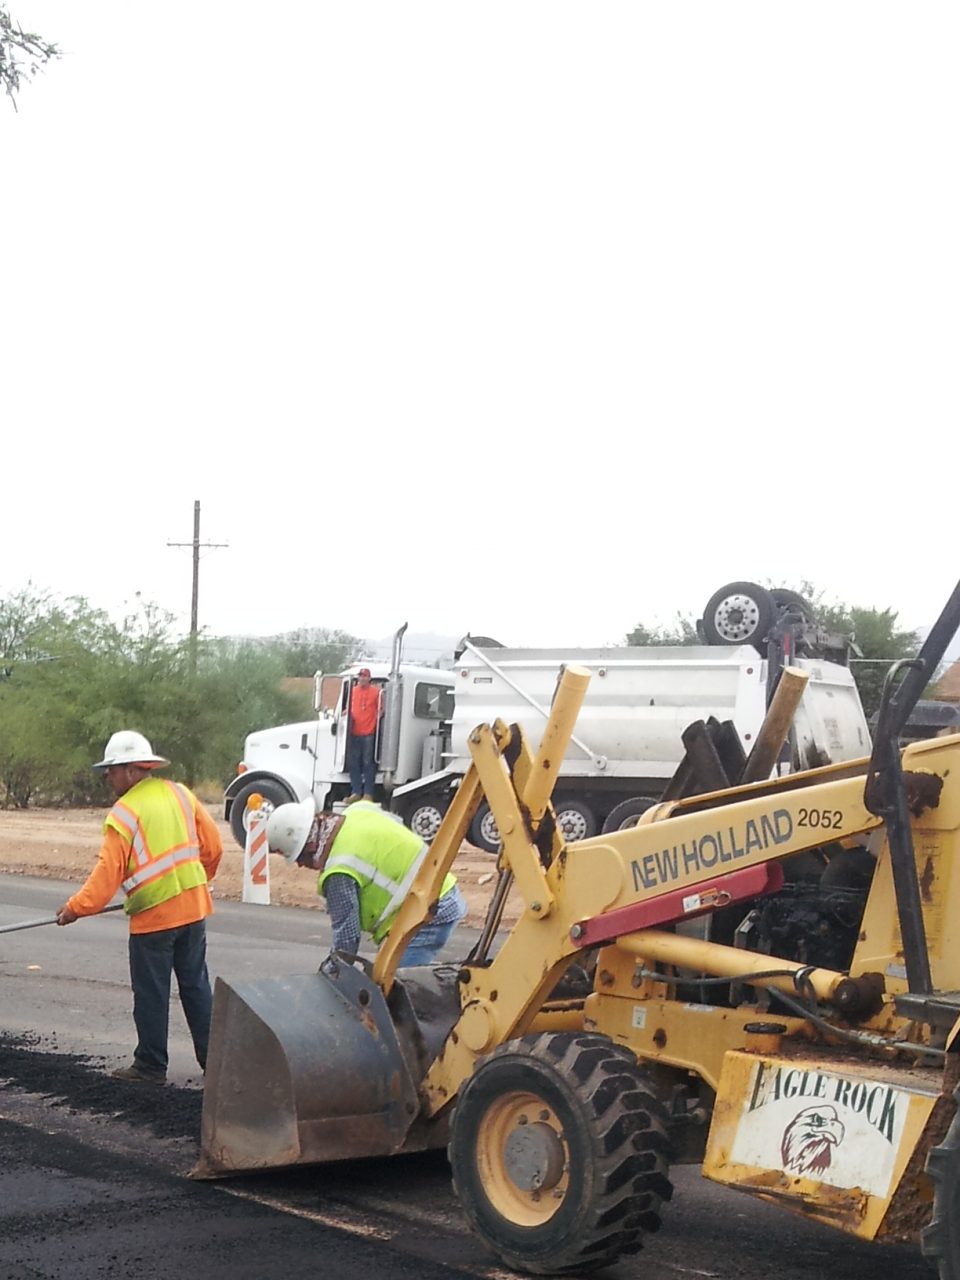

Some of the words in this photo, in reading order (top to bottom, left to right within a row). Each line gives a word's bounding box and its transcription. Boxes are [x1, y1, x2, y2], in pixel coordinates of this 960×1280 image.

[631, 846, 678, 892] NEW
[682, 808, 793, 874] HOLLAND
[797, 808, 843, 829] 2052
[748, 1060, 829, 1113] EAGLE
[834, 1078, 897, 1145] ROCK
